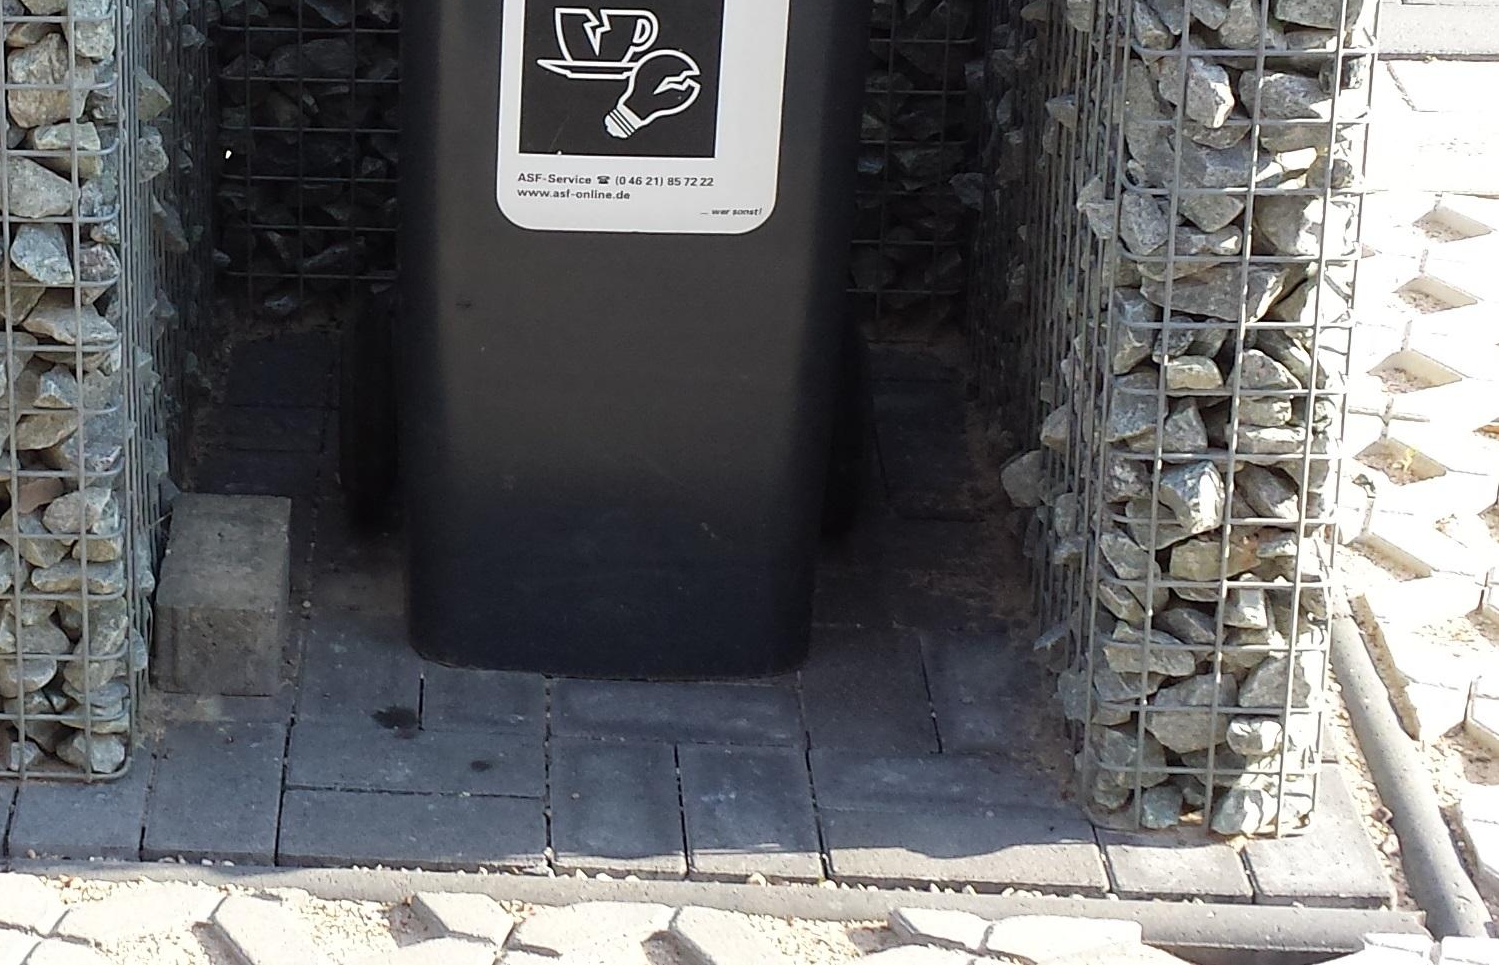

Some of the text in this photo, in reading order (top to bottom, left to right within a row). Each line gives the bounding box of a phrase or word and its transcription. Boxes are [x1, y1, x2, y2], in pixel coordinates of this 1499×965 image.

[517, 172, 592, 185] ASF-Service
[628, 176, 643, 186] 46
[645, 176, 664, 187] 21)
[667, 177, 682, 187] 85
[684, 177, 698, 187] 72
[700, 177, 715, 187] 22
[517, 187, 631, 200] www.asf-online.de
